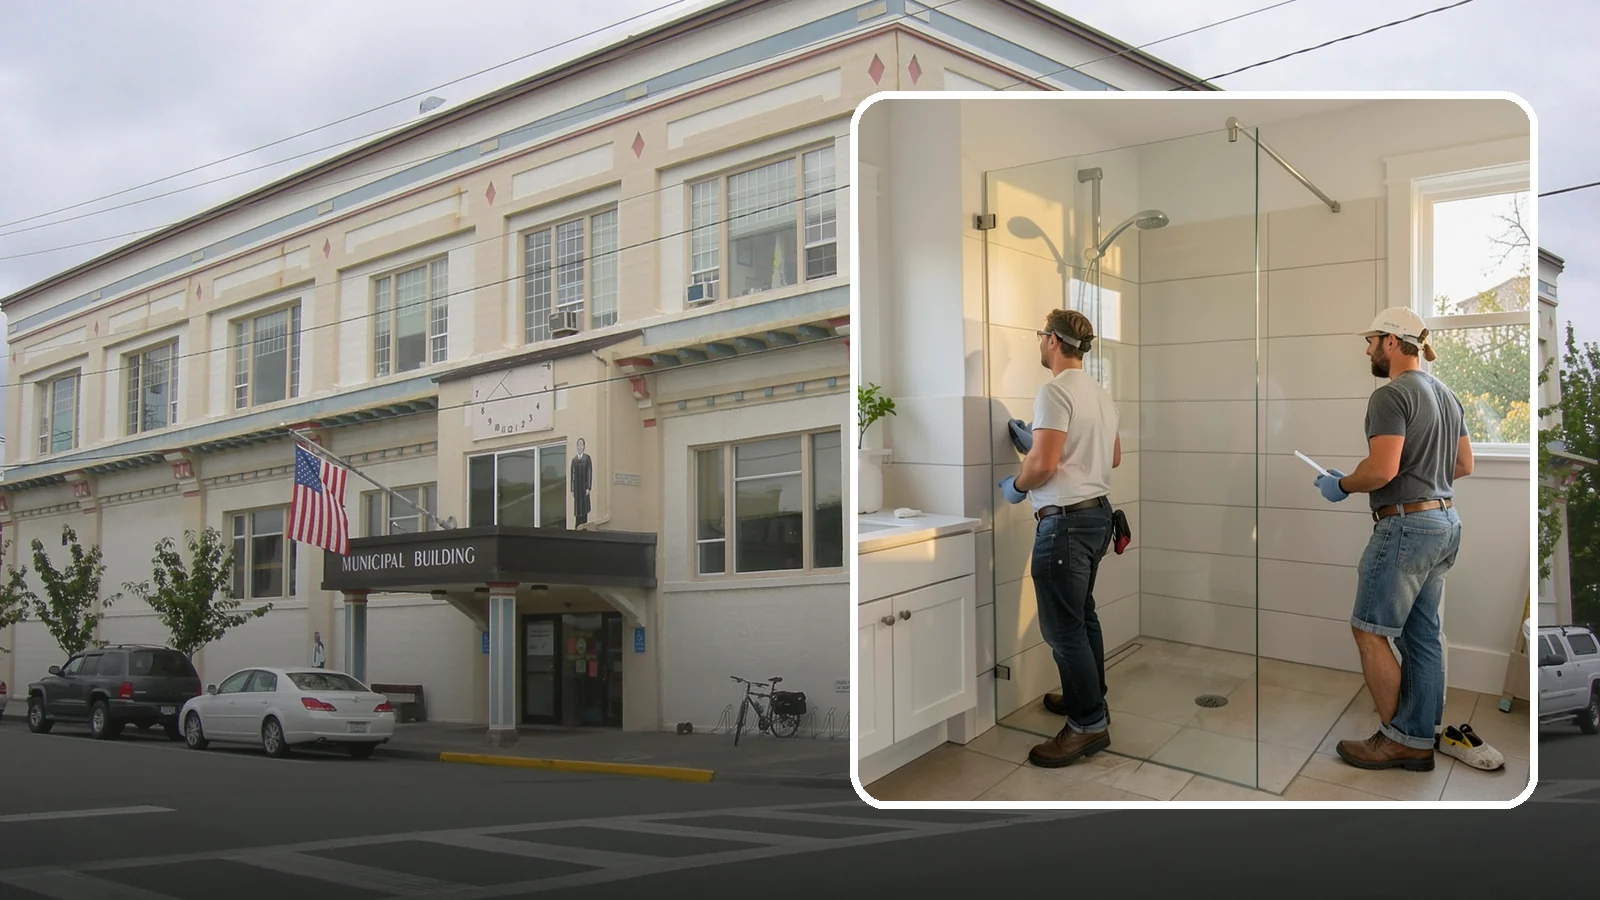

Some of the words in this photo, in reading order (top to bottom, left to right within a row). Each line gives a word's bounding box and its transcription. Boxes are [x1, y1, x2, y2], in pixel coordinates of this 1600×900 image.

[475, 390, 479, 398] 7
[480, 406, 485, 415] 8
[536, 402, 540, 410] 4
[487, 417, 493, 426] 9
[528, 413, 533, 422] 3
[494, 423, 501, 432] 10
[521, 420, 526, 428] 2
[507, 425, 514, 433] 12
[342, 552, 405, 572] MUNICIPAL
[414, 546, 476, 567] BUILDING
